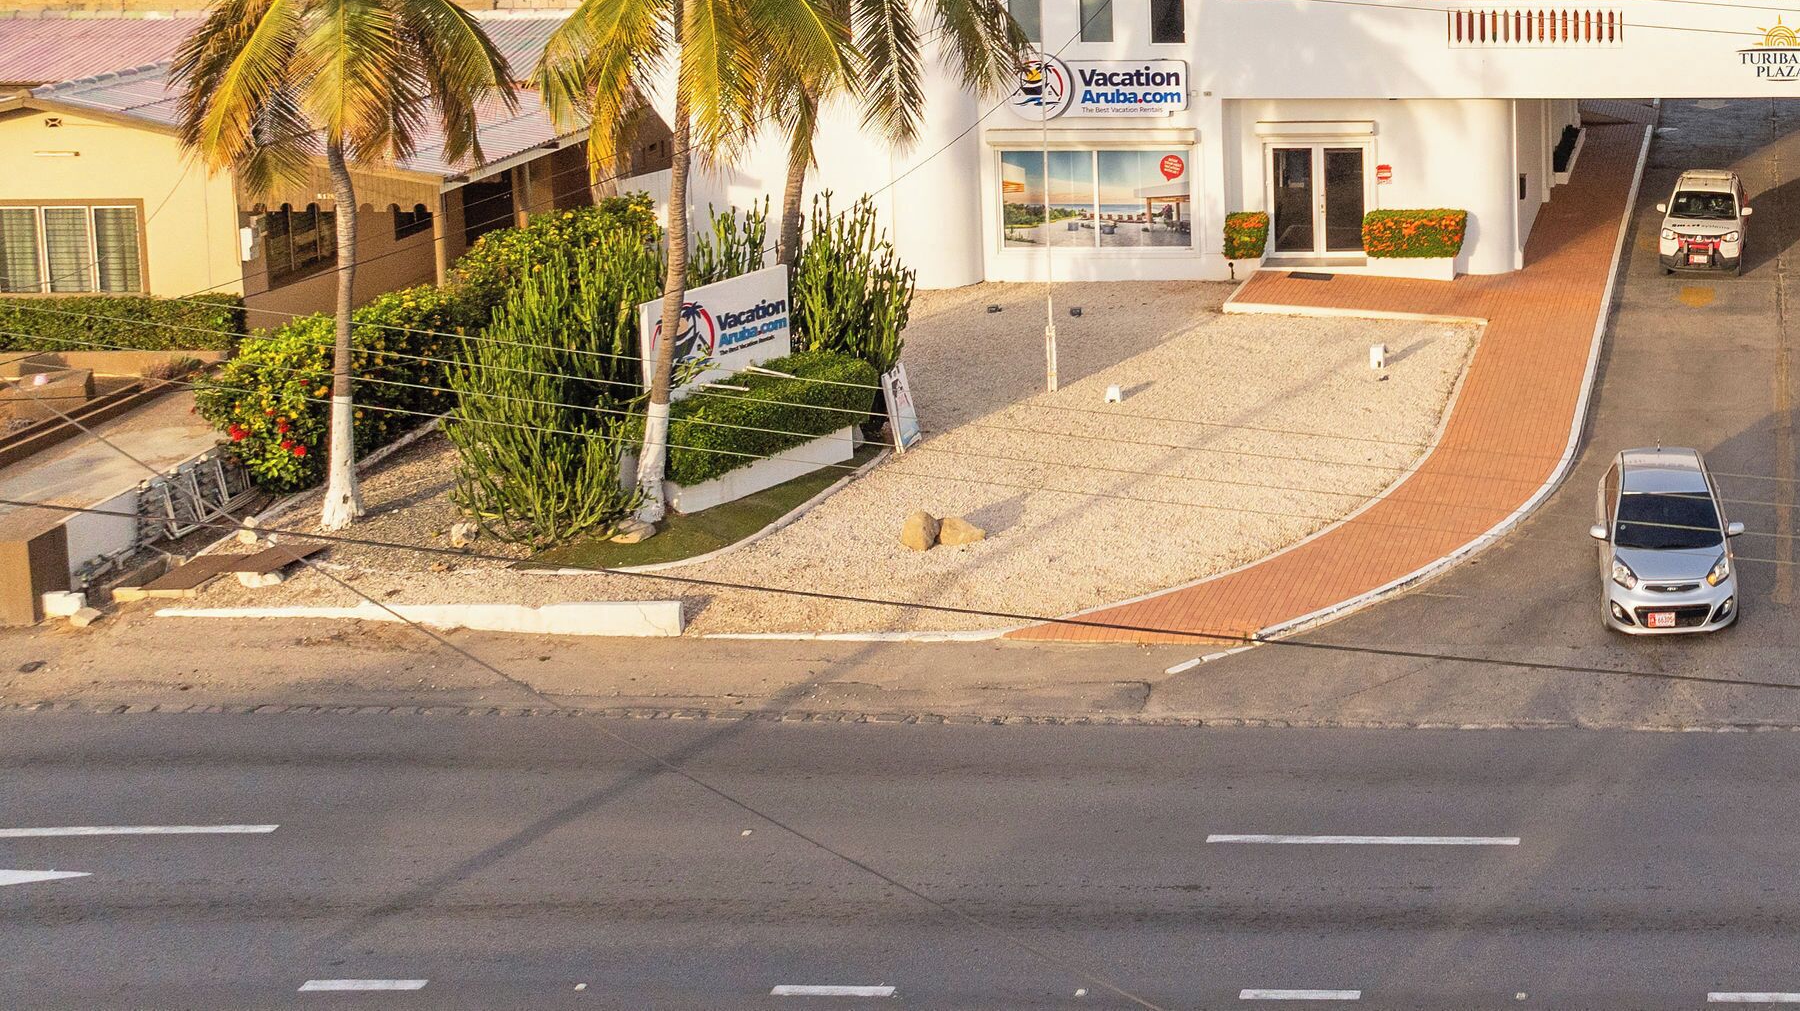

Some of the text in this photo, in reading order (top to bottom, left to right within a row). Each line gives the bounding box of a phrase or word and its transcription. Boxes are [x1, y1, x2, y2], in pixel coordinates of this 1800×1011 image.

[1078, 66, 1180, 87] Vacation
[1080, 89, 1181, 104] Aruba.com
[1095, 106, 1110, 114] Best
[716, 299, 786, 331] Vacation
[718, 317, 787, 349] Aruba.com
